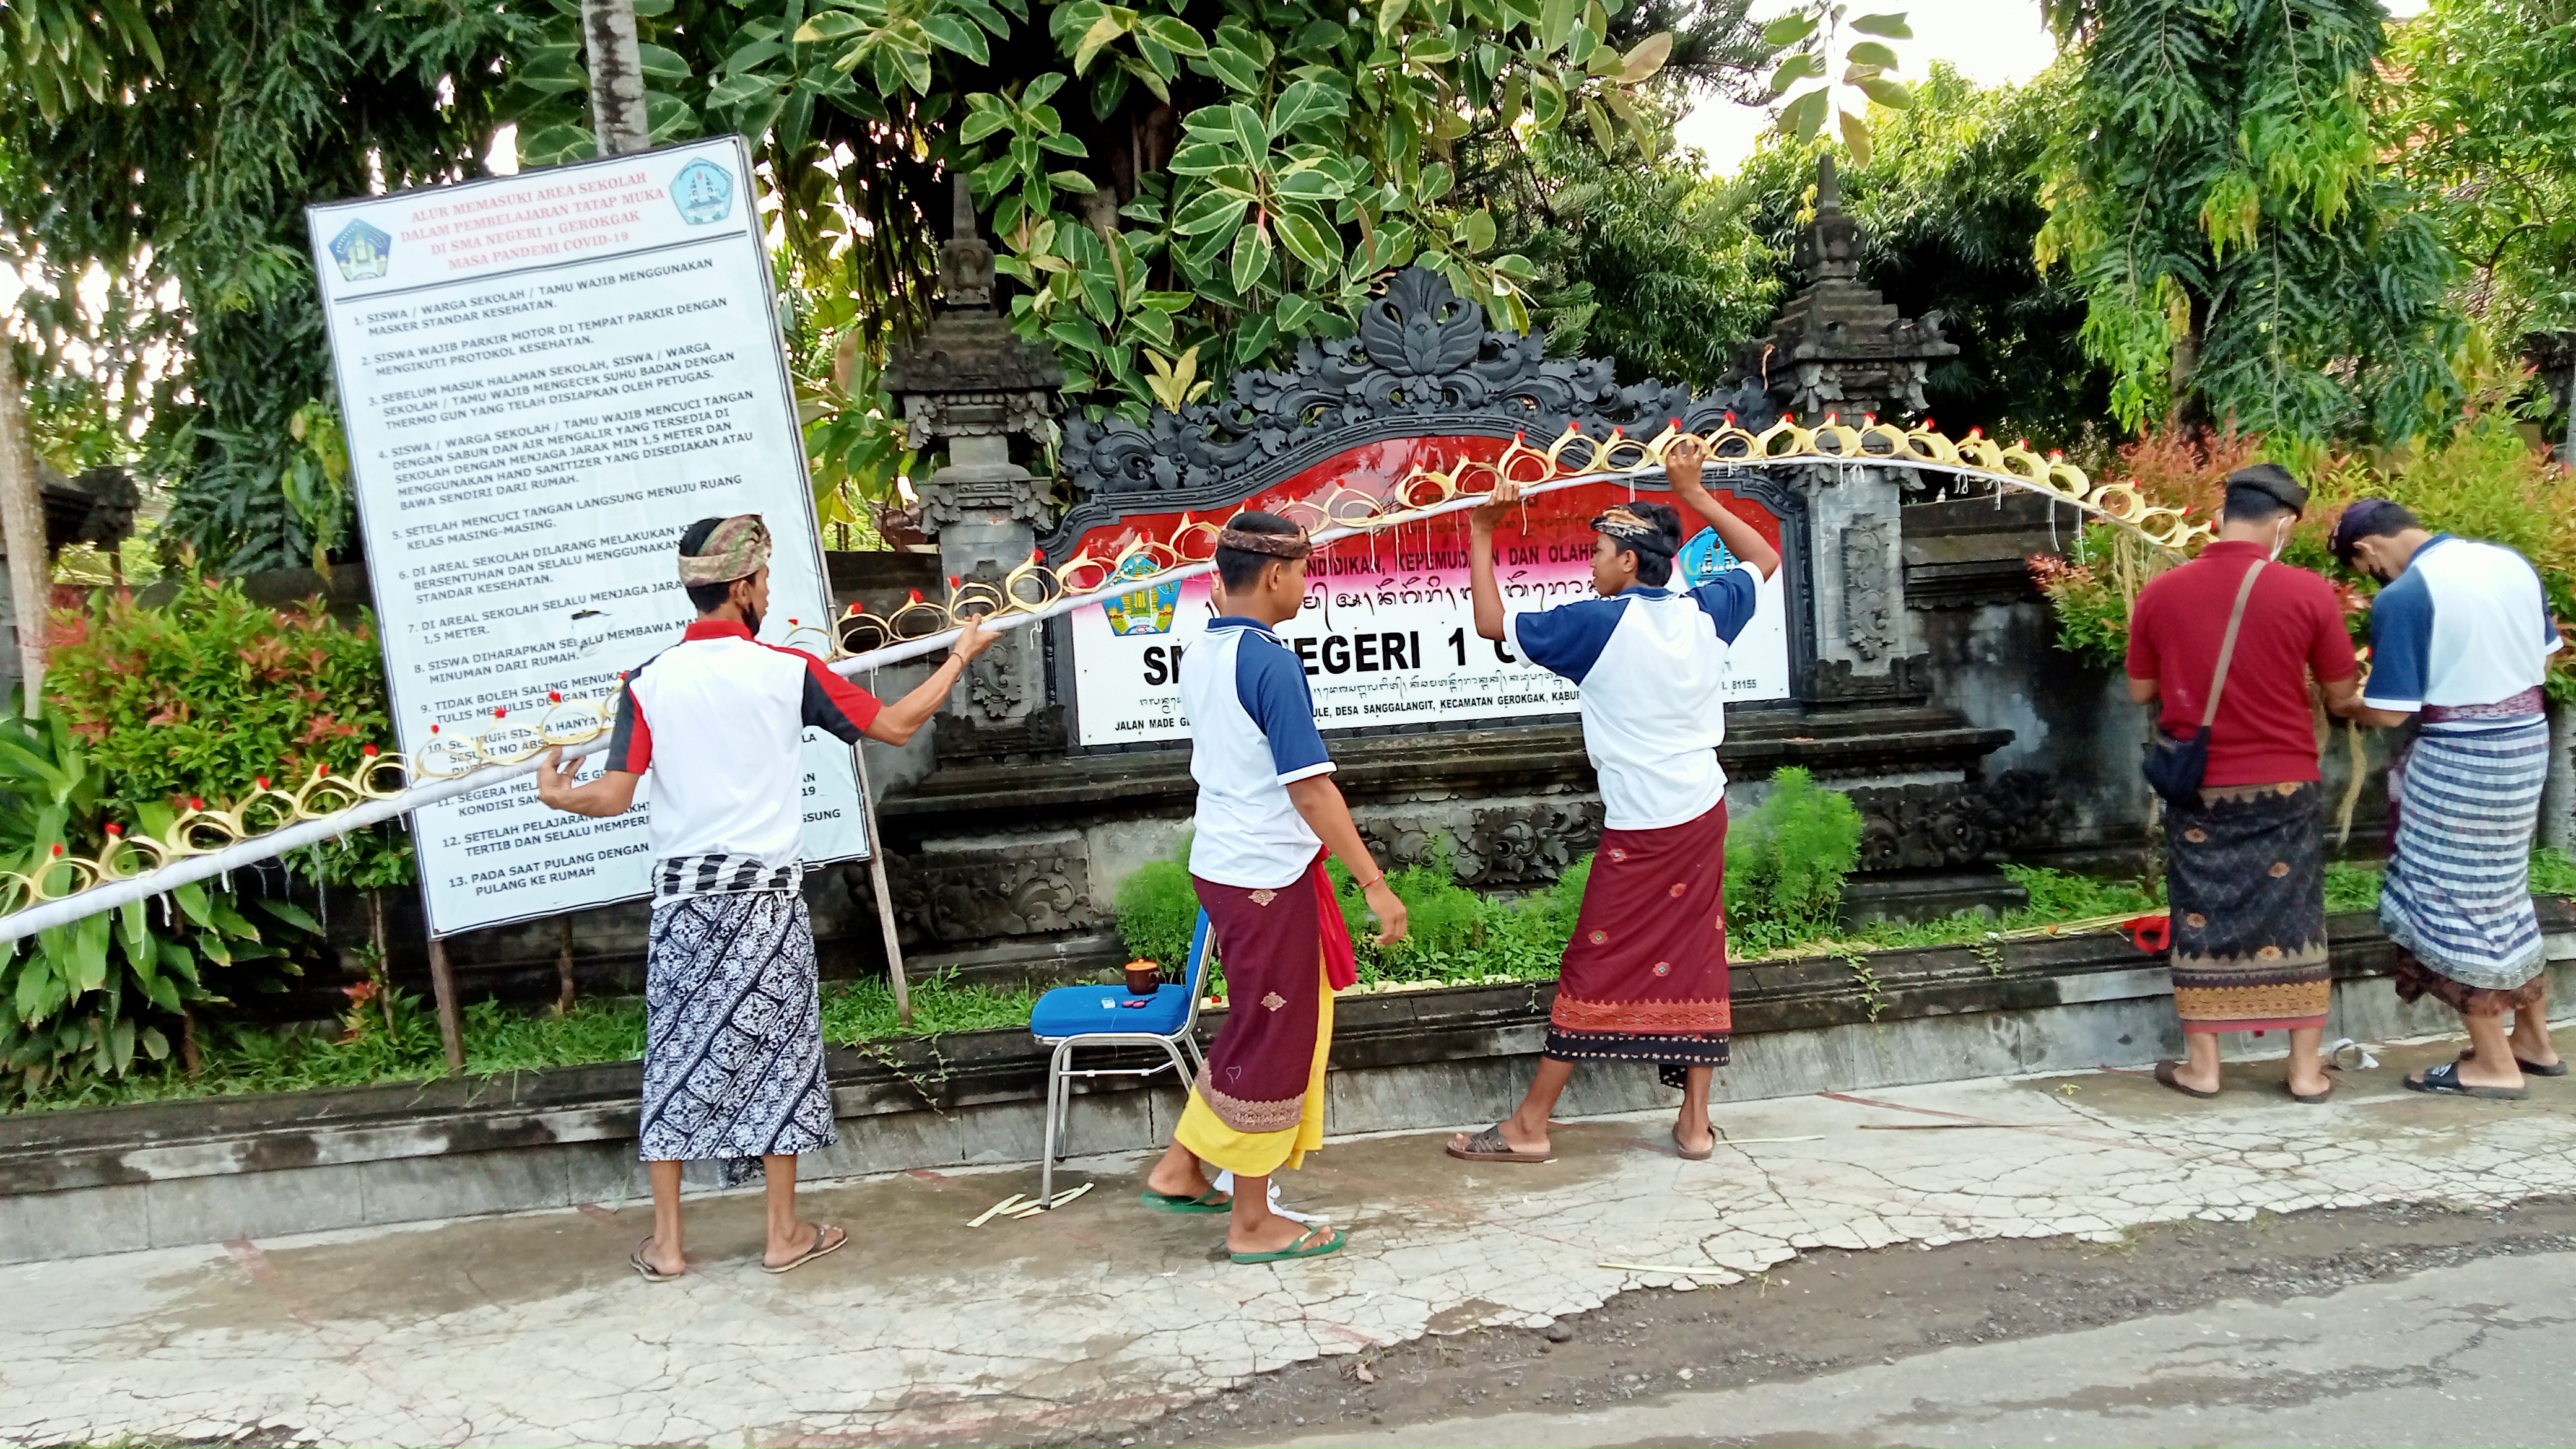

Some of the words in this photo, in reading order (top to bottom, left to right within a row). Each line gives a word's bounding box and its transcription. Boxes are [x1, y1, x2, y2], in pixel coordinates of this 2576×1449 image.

[400, 224, 450, 242] DALAM
[454, 204, 568, 233] PEMBELAJARAN
[572, 196, 617, 212] TATAP
[620, 188, 665, 204] MUKA
[412, 207, 448, 222] ALUR
[453, 191, 533, 214] MEMASUKI
[537, 185, 576, 201] AREA
[578, 172, 646, 194] SEKOLAH
[430, 243, 446, 255] DI
[450, 237, 482, 251] SMA
[485, 227, 542, 245] NEGERI
[558, 210, 640, 233] GEROKGAK
[448, 254, 489, 269] MASA
[492, 242, 560, 262] PANDEMI
[563, 231, 629, 251] COVID-19
[367, 310, 408, 323] SISWA
[420, 300, 467, 315] WARGA
[469, 289, 524, 307] SEKOLAH
[537, 282, 573, 295] TAMU
[576, 275, 616, 290] WAJIB
[619, 258, 713, 282] MENGGUNAKAN
[368, 321, 419, 335] MASKER
[422, 311, 479, 328] STANDAR
[482, 300, 557, 318] KESEHATAN.
[374, 350, 415, 363] SISWA
[417, 342, 458, 355] WAJIB
[461, 334, 508, 349] PARKIR
[511, 326, 556, 341] MOTOR
[559, 324, 574, 334] DI
[577, 315, 623, 331] TEMPAT
[627, 307, 674, 323] PARKIR
[677, 297, 727, 314] DENGAN
[376, 358, 446, 376] MENGIKUTI
[450, 347, 515, 365] PROTOKOL
[518, 336, 594, 354] KESEHATAN.
[381, 386, 437, 403] SEBELUM
[440, 380, 484, 393] MASUK
[487, 370, 546, 386] HALAMAN
[549, 360, 609, 376] SEKOLAH,
[612, 352, 653, 367] SISWA
[665, 342, 711, 357] WARGA
[383, 400, 438, 417] SEKOLAH
[451, 393, 486, 406] TAMU
[490, 385, 530, 399] WAJIB
[533, 375, 601, 392] MENGECEK
[603, 369, 636, 383] SUHU
[639, 361, 682, 376] BADAN
[684, 352, 734, 368] DENGAN
[385, 414, 436, 429] THERMO
[440, 410, 466, 421] GUN
[470, 404, 504, 416] YANG
[507, 398, 546, 410] TELAH
[549, 386, 619, 404] DISIAPKAN
[622, 380, 653, 393] OLEH
[656, 370, 714, 386] PETUGAS.
[391, 442, 432, 457] SISWA
[445, 433, 492, 448] WARGA
[494, 424, 550, 440] SEKOLAH
[562, 416, 598, 429] TAMU
[601, 409, 642, 424] WAJIB
[645, 399, 701, 417] MENCUCI
[703, 390, 754, 406] TANGAN
[393, 455, 443, 470] DENGAN
[447, 448, 489, 461] SABUN
[492, 443, 518, 454] DAN
[522, 438, 544, 450] AIR
[547, 428, 613, 445] MENGALIR
[615, 422, 650, 435] YANG
[651, 411, 712, 429] TERSEDIA
[395, 468, 450, 484] SEKOLAH
[454, 458, 505, 474] DENGAN
[509, 449, 567, 465] MENJAGA
[570, 442, 609, 456] JARAK
[612, 438, 638, 449] MIN
[663, 427, 704, 441] METER
[706, 422, 731, 433] DAN
[398, 474, 493, 495] MENGGUNAKAN
[497, 468, 531, 481] HAND
[535, 457, 602, 475] SANITIZER
[604, 451, 639, 463] YANG
[643, 438, 718, 458] DISEDIAKAN
[722, 432, 752, 445] ATAU
[400, 497, 436, 510] BAWA
[438, 487, 492, 504] SENDIRI
[496, 482, 528, 495] DARI
[531, 475, 578, 489] RUMAH.
[406, 521, 458, 537] SETELAH
[461, 511, 520, 527] MENCUCI
[523, 502, 573, 517] TANGAN
[576, 491, 643, 509] LANGSUNG
[646, 483, 696, 498] MENUJU
[700, 474, 742, 489] RUANG
[407, 536, 444, 550] KELAS
[447, 519, 556, 543] MASING-MASING.
[430, 560, 469, 573] AREAL
[472, 550, 529, 567] SEKOLAH
[533, 539, 596, 557] DILARANG
[599, 527, 675, 546] MELAKUKAN
[414, 568, 504, 590] BERSENTUHAN
[508, 563, 534, 575] DAN
[537, 555, 581, 570] SELALU
[1303, 555, 1386, 577] NDIDIKAN,
[1395, 549, 1499, 572] KEPEMUDN
[1508, 546, 1539, 565] DAN
[416, 586, 474, 604] STANDAR
[477, 575, 553, 593] KESEHATAN.
[440, 614, 479, 627] AREAL
[482, 604, 539, 620] SEKOLAH
[542, 595, 586, 611] SELALU
[590, 586, 649, 602] MENJAGA
[652, 578, 683, 593] JARA
[428, 656, 469, 671] SISWA
[472, 642, 555, 663] DIHARAPKAN
[607, 622, 672, 640] MEMBAWA
[444, 625, 490, 640] METER.
[1293, 630, 1421, 676] EGERI
[1448, 627, 1466, 666] 1
[429, 666, 492, 684] MINUMAN
[495, 659, 528, 672] DARI
[531, 652, 580, 667] RUMAH.
[434, 697, 473, 710] TIDAK
[477, 689, 518, 703] BOLEH
[521, 680, 568, 696] SALING
[436, 710, 472, 724] TULIS
[537, 691, 587, 707] DEGAN
[1115, 720, 1144, 731] JALAN
[1149, 718, 1174, 728] MADE
[1336, 706, 1359, 716] DESA
[1364, 700, 1435, 714] SANGGALANGIT,
[1440, 697, 1492, 708] KECAMATAN
[1498, 693, 1548, 705] GEROKGAK,
[1732, 679, 1756, 689] 81155
[555, 716, 598, 733] HANYA
[459, 785, 508, 802] SEGERA
[459, 798, 515, 816] KONDISI
[464, 825, 519, 843] SETELAH
[464, 840, 511, 856] TERTIB
[515, 835, 541, 847] DAN
[544, 826, 590, 842] SELALU
[471, 869, 505, 883] PADA
[509, 862, 540, 876] SAAT
[544, 853, 594, 869] PULANG
[598, 842, 649, 860] DENGAN
[476, 879, 526, 895] PULANG
[530, 875, 546, 886] KE
[549, 866, 595, 882] RUMAH
